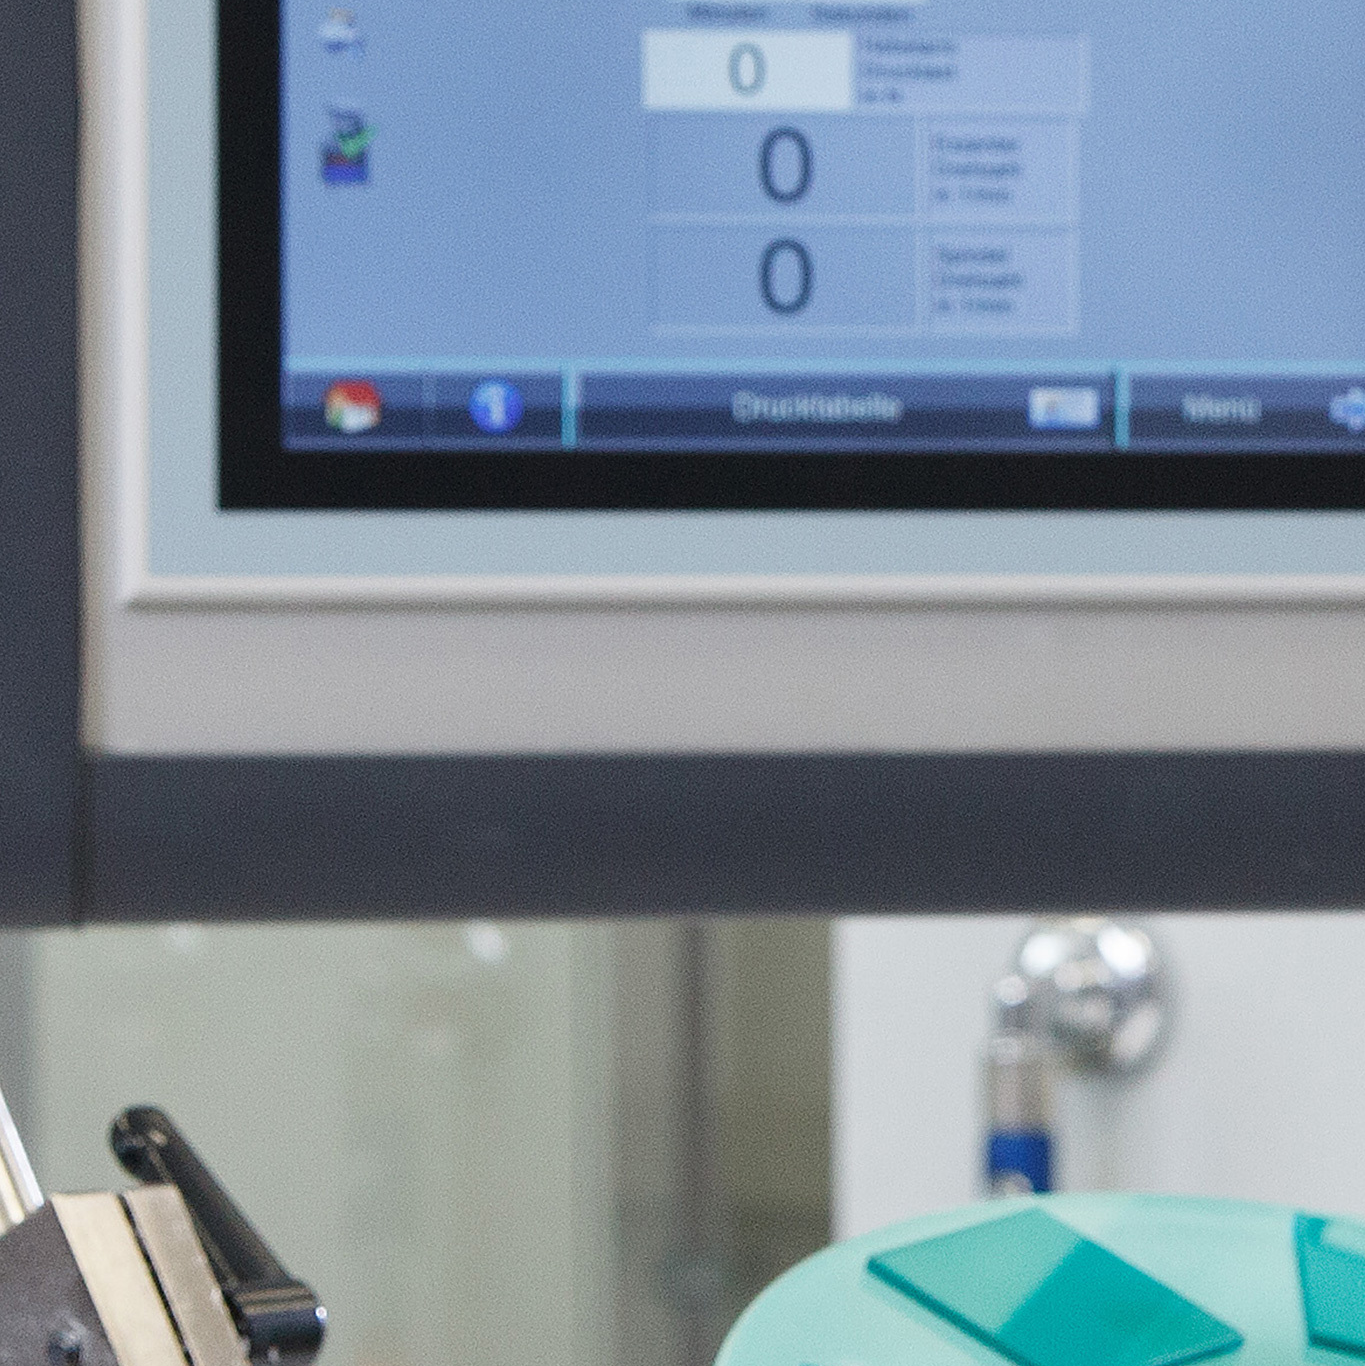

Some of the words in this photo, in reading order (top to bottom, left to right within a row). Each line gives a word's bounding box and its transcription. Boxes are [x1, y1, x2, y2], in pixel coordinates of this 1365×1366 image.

[728, 42, 767, 97] 0
[758, 125, 813, 204] 0
[758, 237, 814, 315] 0
